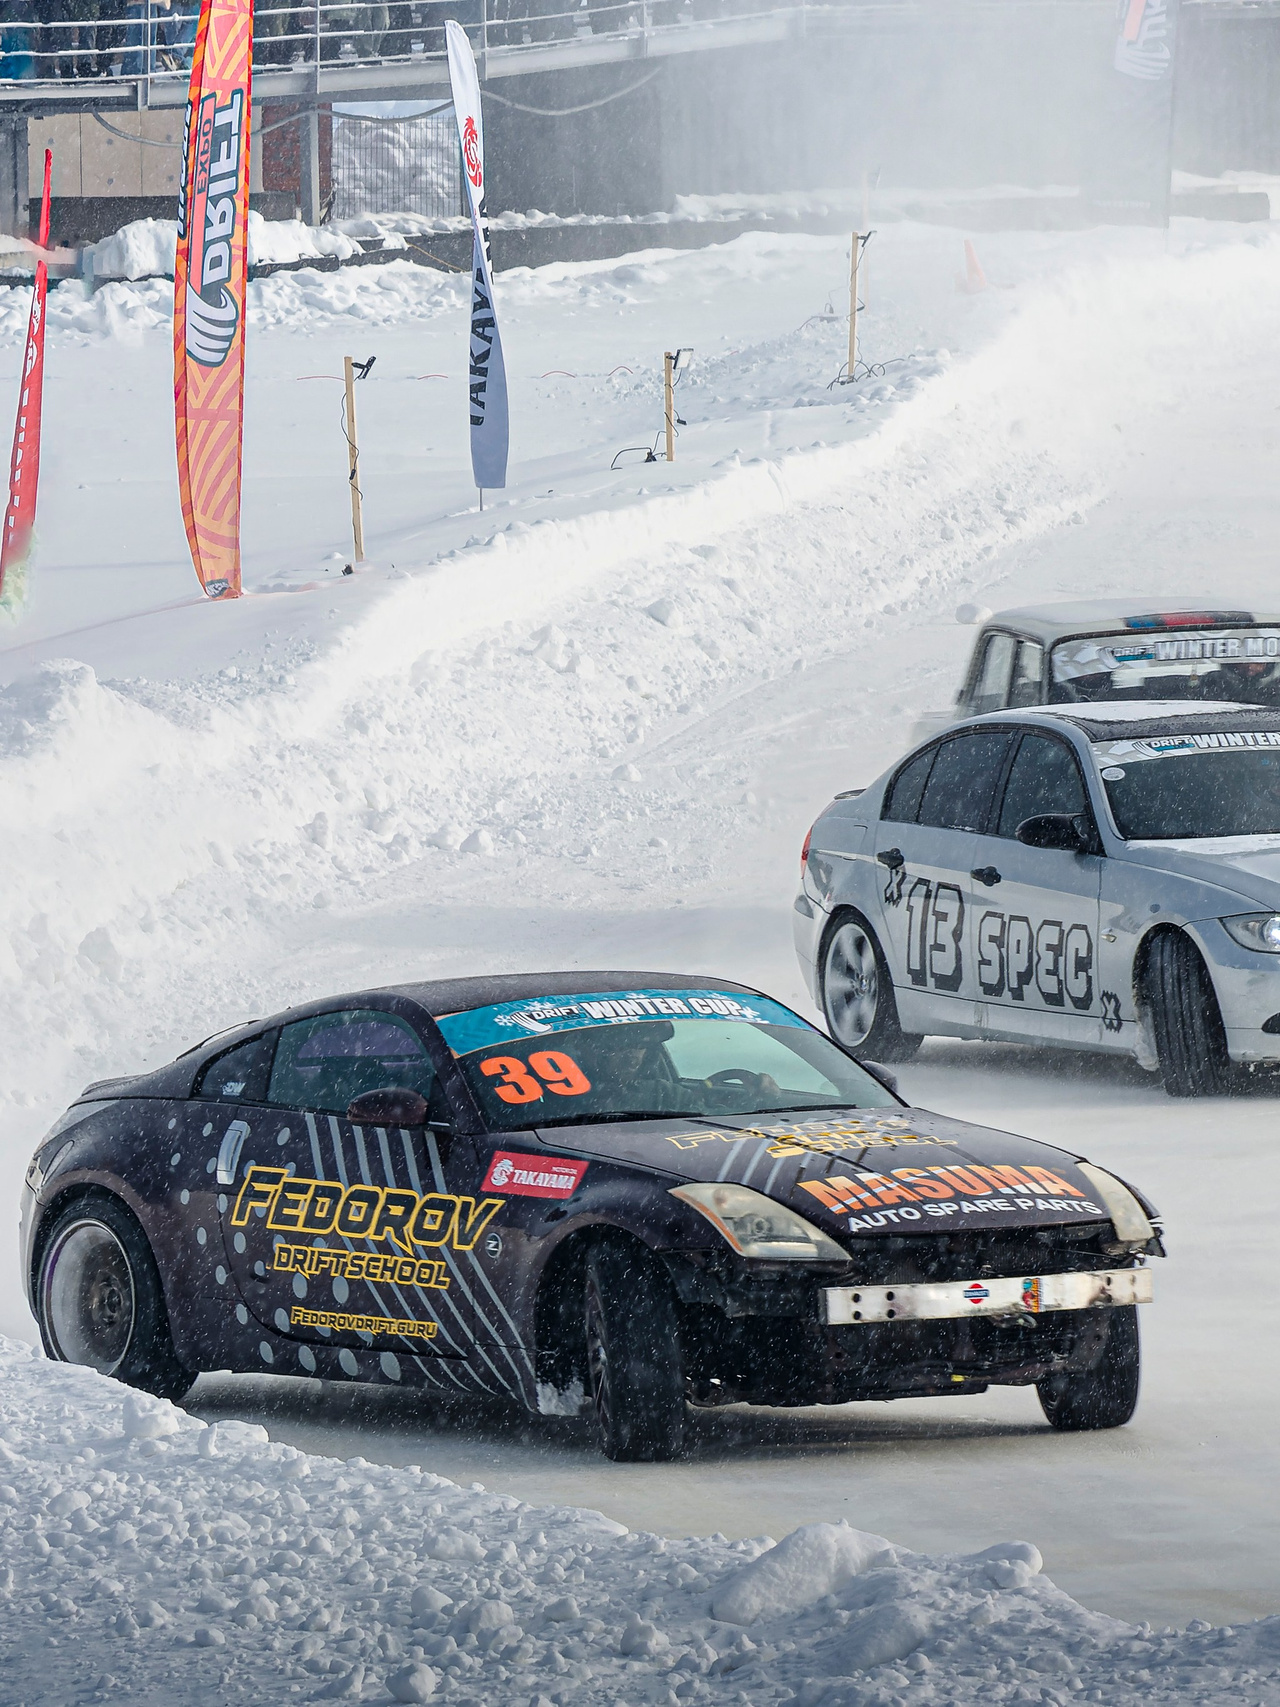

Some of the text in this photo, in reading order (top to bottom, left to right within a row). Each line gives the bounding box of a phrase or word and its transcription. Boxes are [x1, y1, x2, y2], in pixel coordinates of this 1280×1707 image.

[1155, 638, 1241, 661] WINTER
[1150, 736, 1192, 749] DRIFT
[907, 877, 1093, 1011] 13 SPEC
[534, 997, 743, 1020] DRIFT WINTER CUP
[479, 1050, 592, 1104] 39
[512, 1169, 575, 1190] TAKAYAMA
[797, 1164, 1086, 1215] MASUMA
[231, 1166, 506, 1257] FEDOROV
[849, 1197, 1103, 1232] AUTO SPARE PARTS
[290, 1306, 438, 1341] FEDOROVDRIFT.GURU
